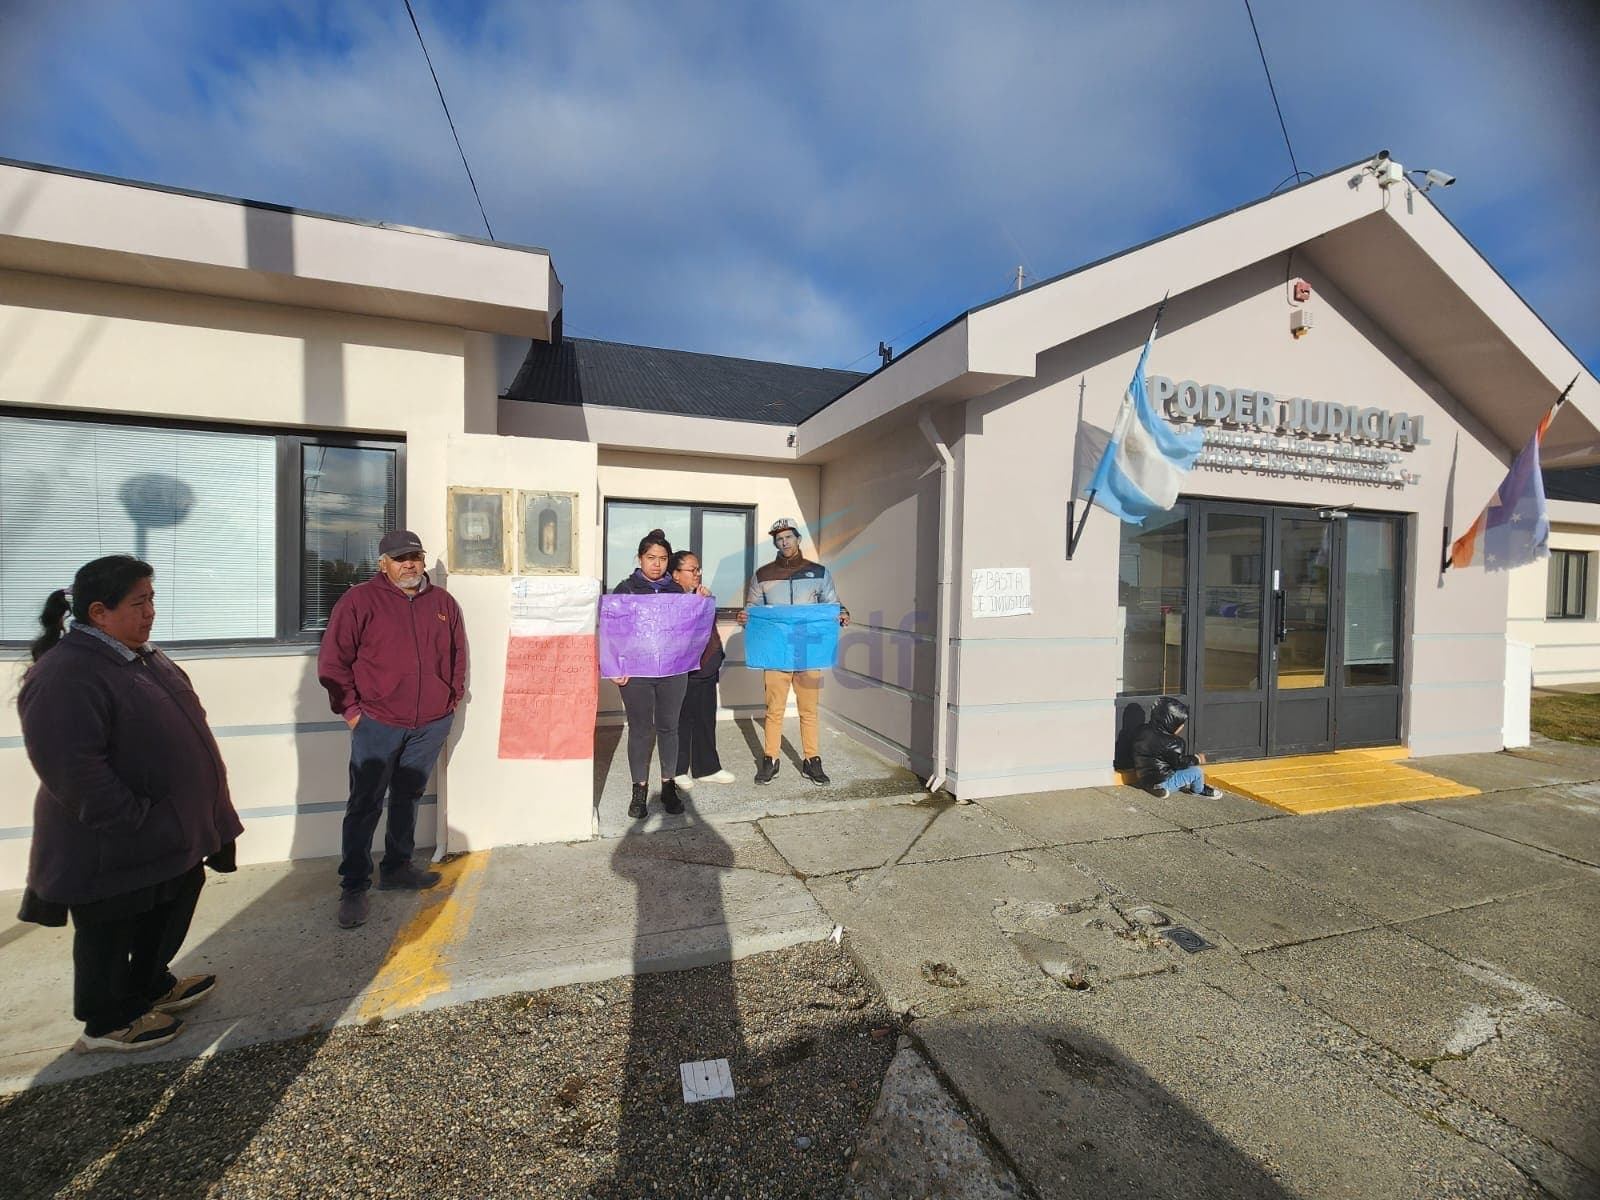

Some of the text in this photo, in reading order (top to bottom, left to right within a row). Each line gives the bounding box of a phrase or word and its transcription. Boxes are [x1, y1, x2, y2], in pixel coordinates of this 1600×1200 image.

[1148, 375, 1431, 446] PODER JUDICIAL
[1400, 468, 1421, 486] Sur
